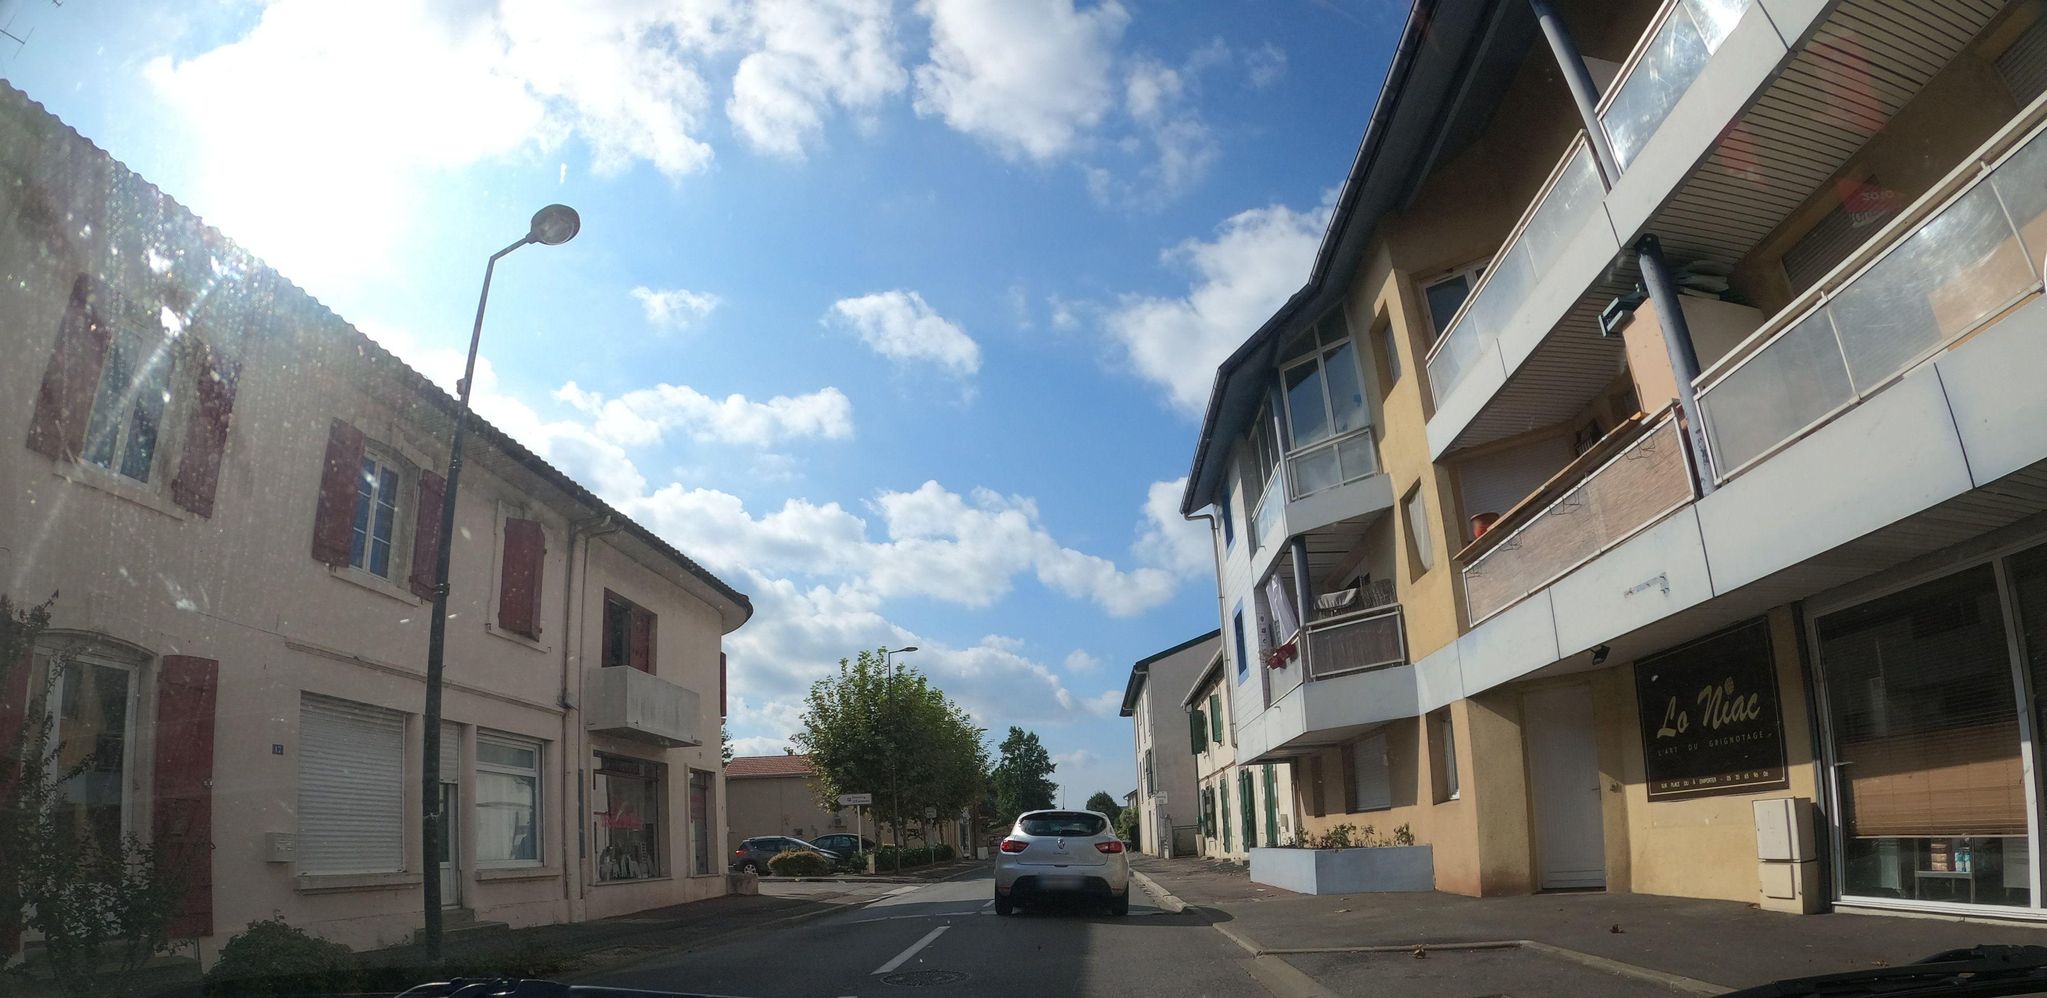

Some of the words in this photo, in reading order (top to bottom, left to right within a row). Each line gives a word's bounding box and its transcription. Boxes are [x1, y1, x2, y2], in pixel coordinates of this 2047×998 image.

[1656, 695, 1689, 739] Lo
[1697, 677, 1760, 730] Niac
[1687, 743, 1698, 752] DU
